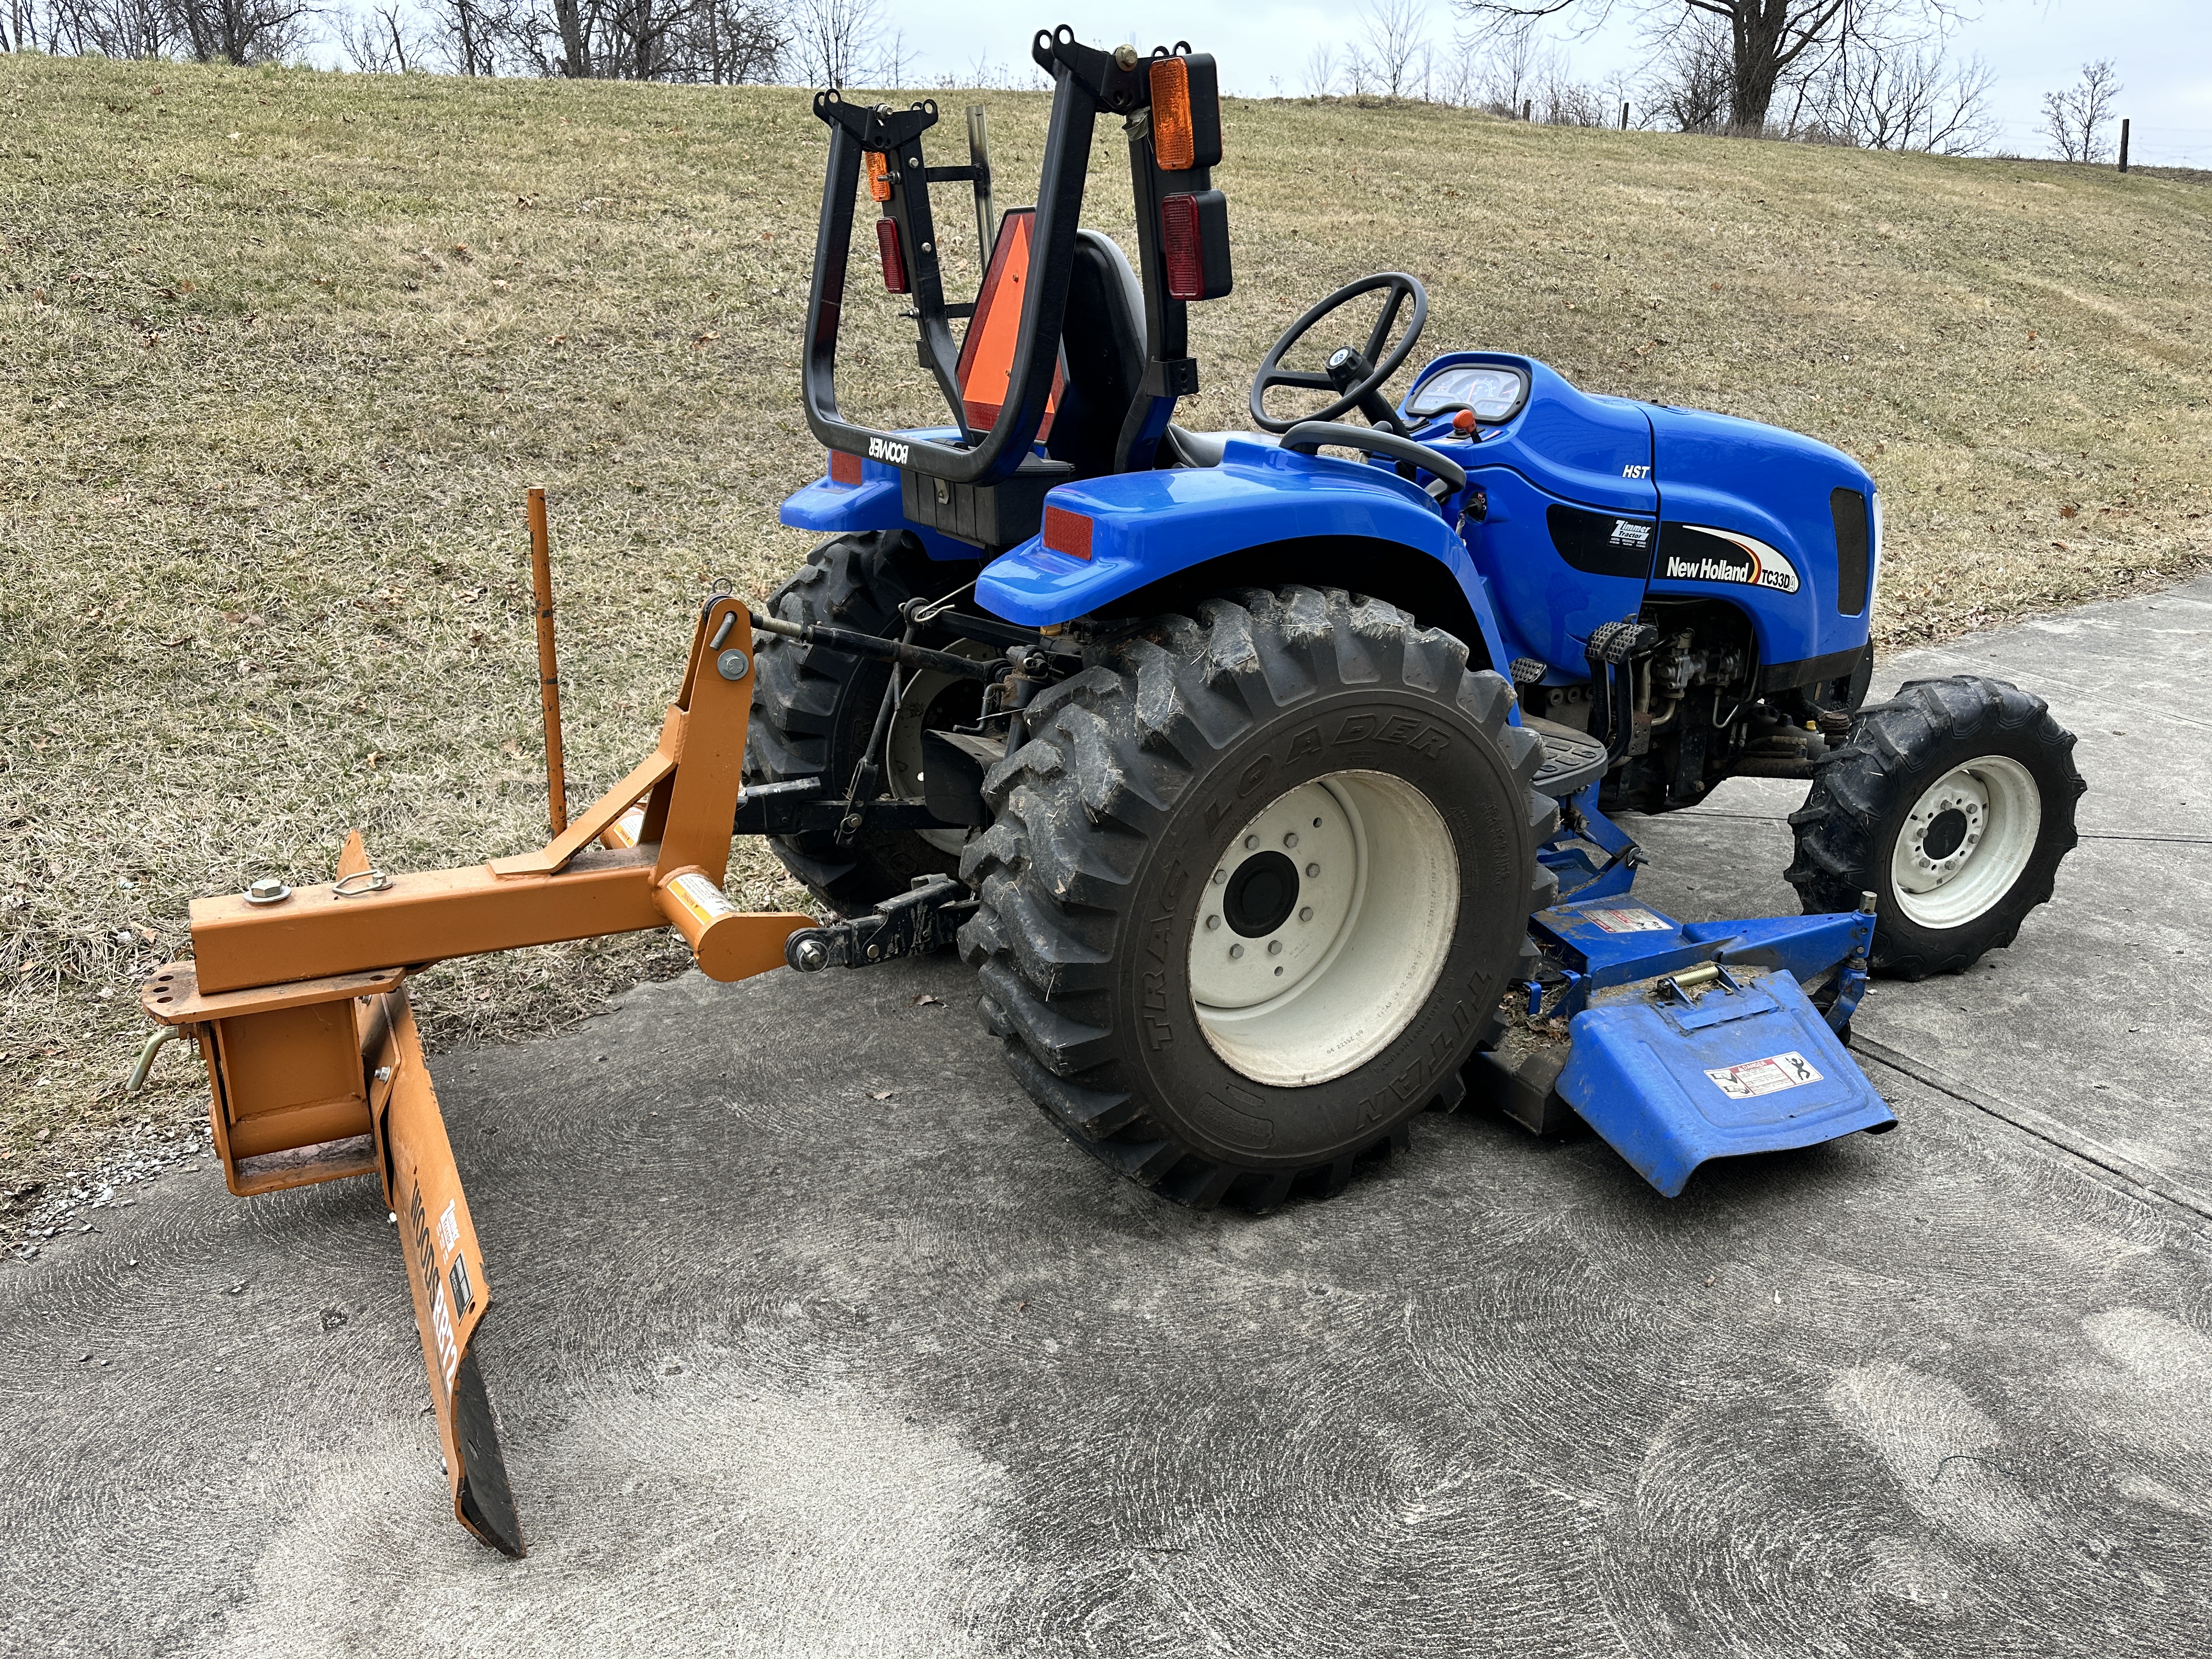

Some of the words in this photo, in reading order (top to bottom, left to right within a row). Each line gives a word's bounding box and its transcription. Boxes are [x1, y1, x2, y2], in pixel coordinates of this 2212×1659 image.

[868, 437, 909, 465] BOOMER
[1622, 464, 1650, 479] HST
[1611, 520, 1651, 537] Zimmer
[1618, 531, 1643, 539] Tractor
[1667, 556, 1700, 579] New
[1700, 558, 1750, 583] Holland
[1762, 569, 1795, 592] TC33DA
[1142, 856, 1189, 1052] TRAC
[1206, 714, 1453, 836] LOADER
[1355, 969, 1492, 1132] TITAN
[1742, 1060, 1767, 1071] DANGER
[410, 1178, 439, 1312] WOODS
[433, 1280, 458, 1396] RB72
